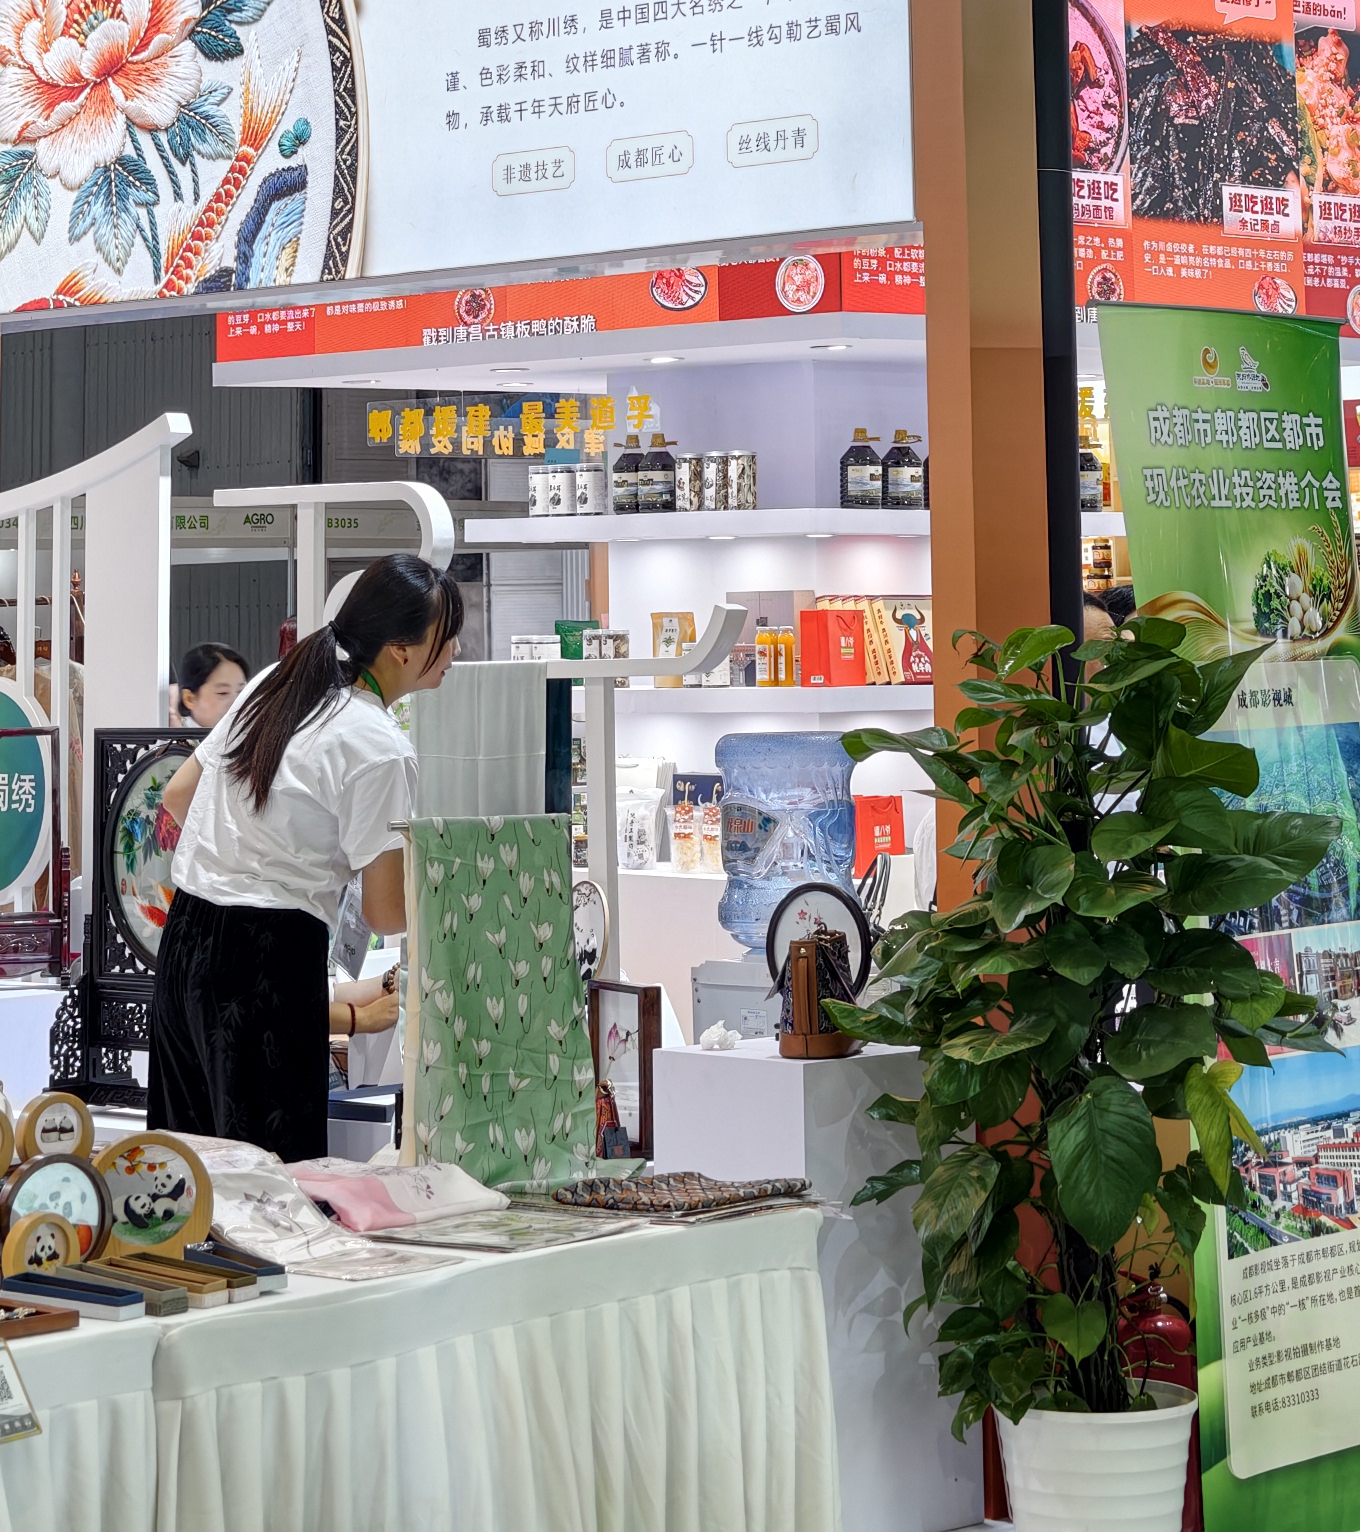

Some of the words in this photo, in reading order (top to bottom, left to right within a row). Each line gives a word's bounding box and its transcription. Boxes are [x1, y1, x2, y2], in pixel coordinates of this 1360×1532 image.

[738, 127, 807, 155] 丝线丹青
[617, 144, 683, 171] 成都匠心
[502, 158, 565, 185] 非遗技艺
[1229, 192, 1290, 217] 逛吃逛吃
[1148, 405, 1325, 452] 成都市郫都区都市
[1143, 467, 1344, 510] 现代农业投资推介会
[243, 513, 275, 526] AGRO
[327, 518, 359, 529] B3035
[1237, 687, 1294, 711] 成都影视城
